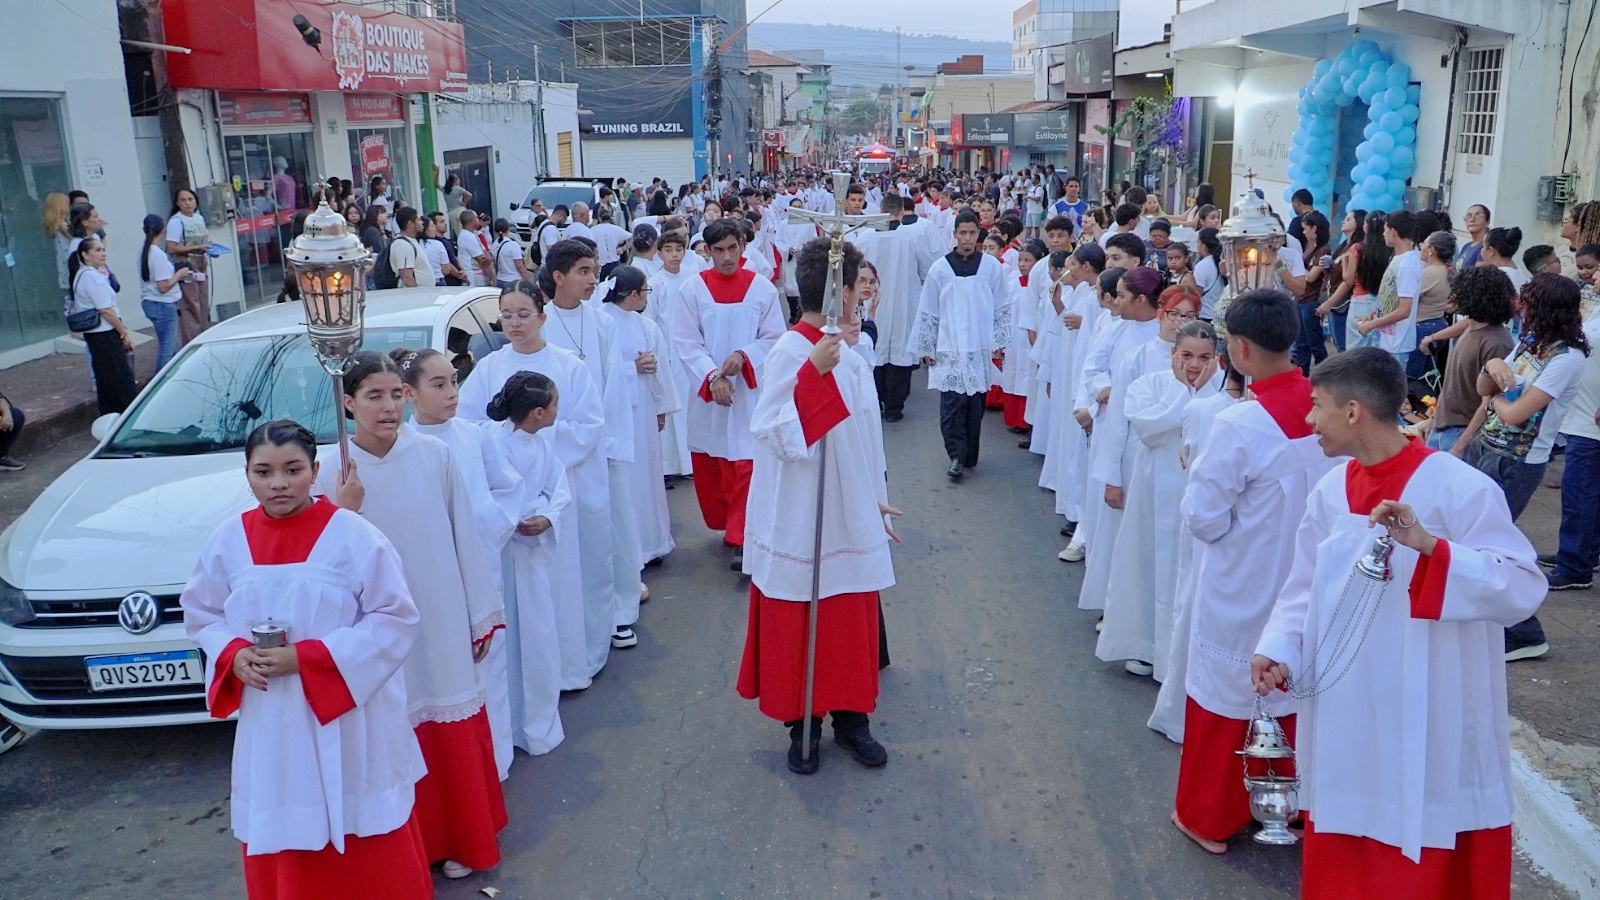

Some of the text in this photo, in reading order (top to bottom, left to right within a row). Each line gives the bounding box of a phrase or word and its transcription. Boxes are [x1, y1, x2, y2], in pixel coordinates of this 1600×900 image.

[366, 22, 425, 51] BOUTIQUE
[366, 49, 430, 75] DAS MAKES
[592, 122, 684, 134] TUNING BRAZIL
[100, 662, 191, 685] QVS2C91
